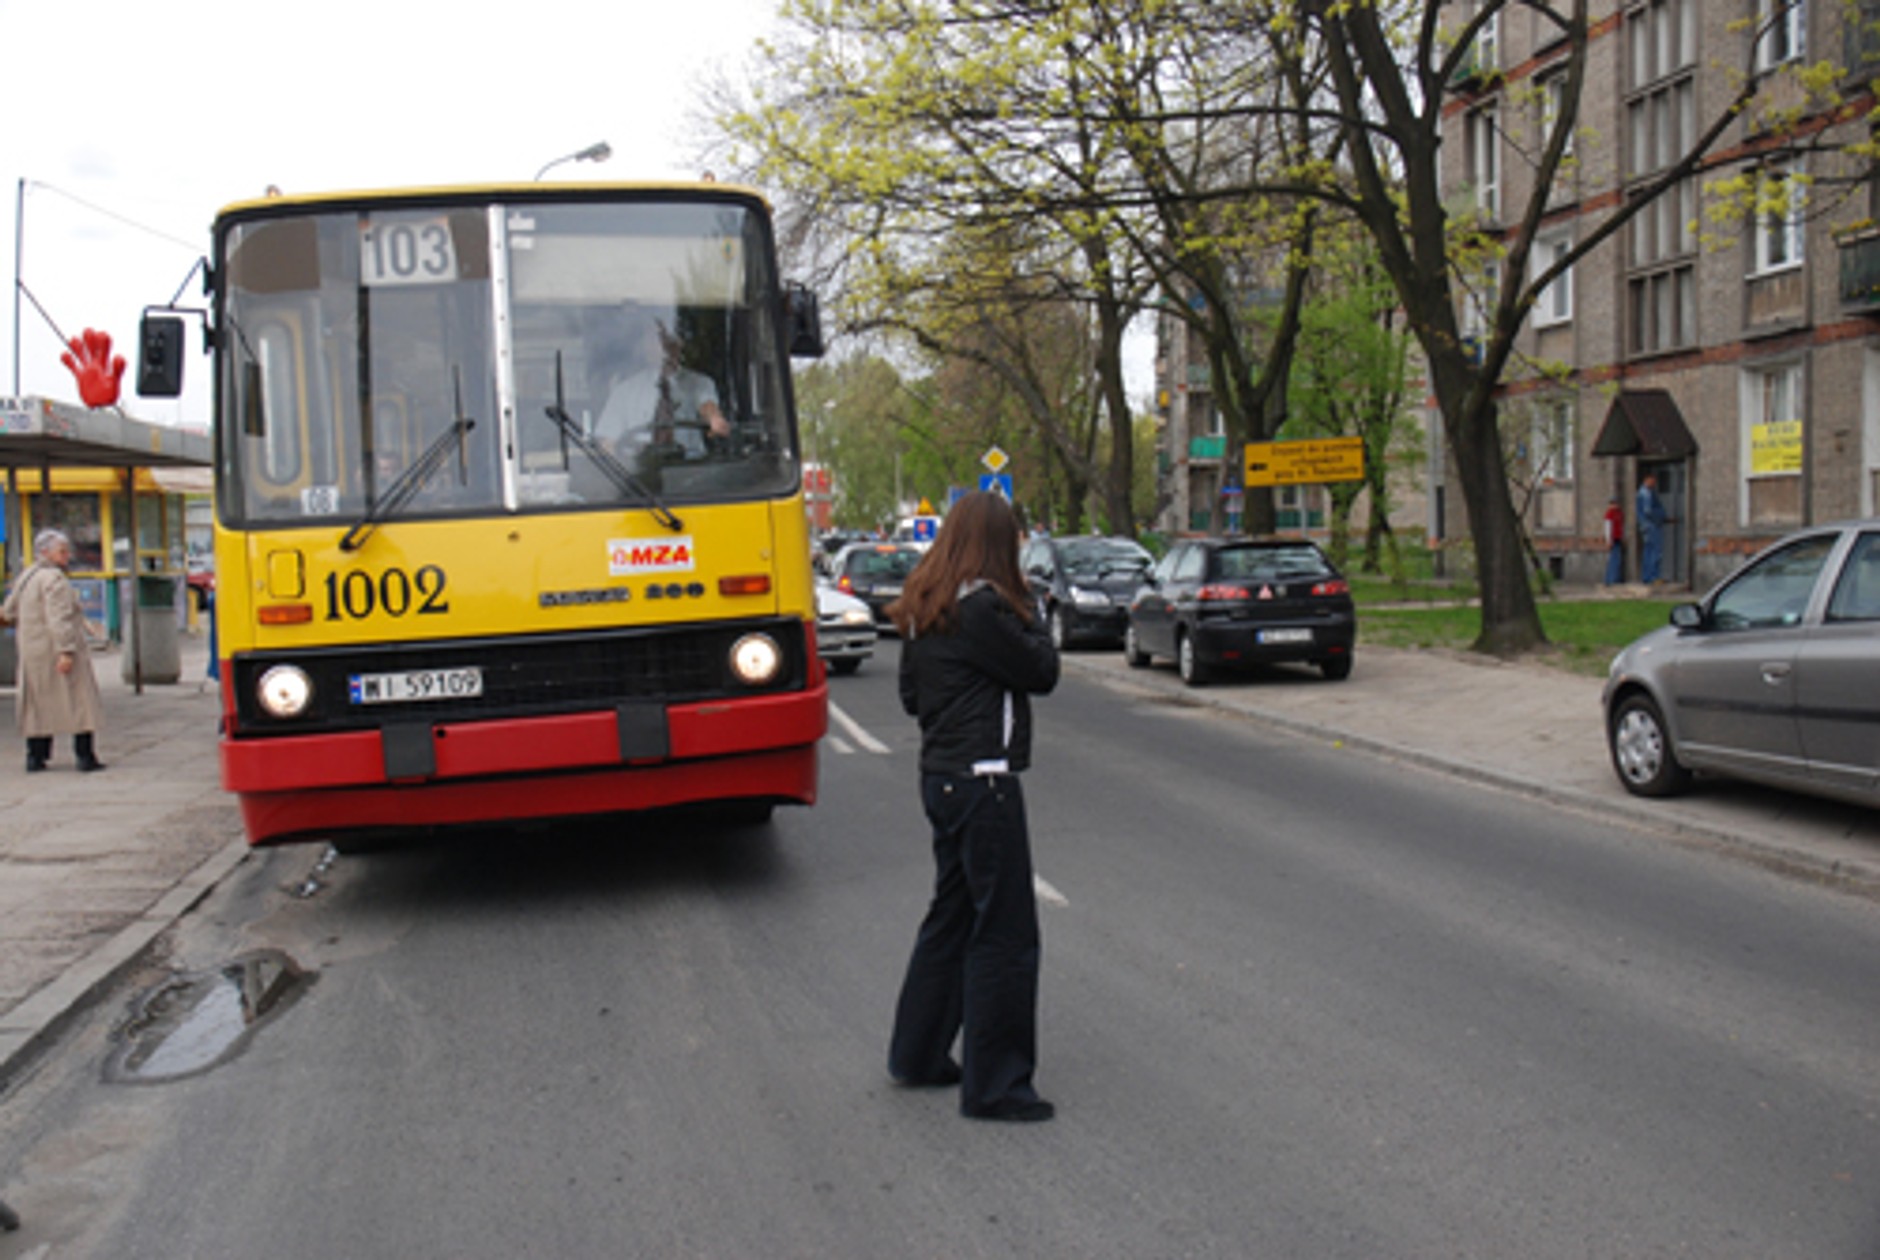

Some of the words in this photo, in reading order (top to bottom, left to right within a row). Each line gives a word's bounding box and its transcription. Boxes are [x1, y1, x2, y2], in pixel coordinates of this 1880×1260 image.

[365, 223, 450, 279] 103
[631, 543, 690, 565] MZA
[324, 563, 449, 621] 1002
[405, 671, 479, 697] 59109
